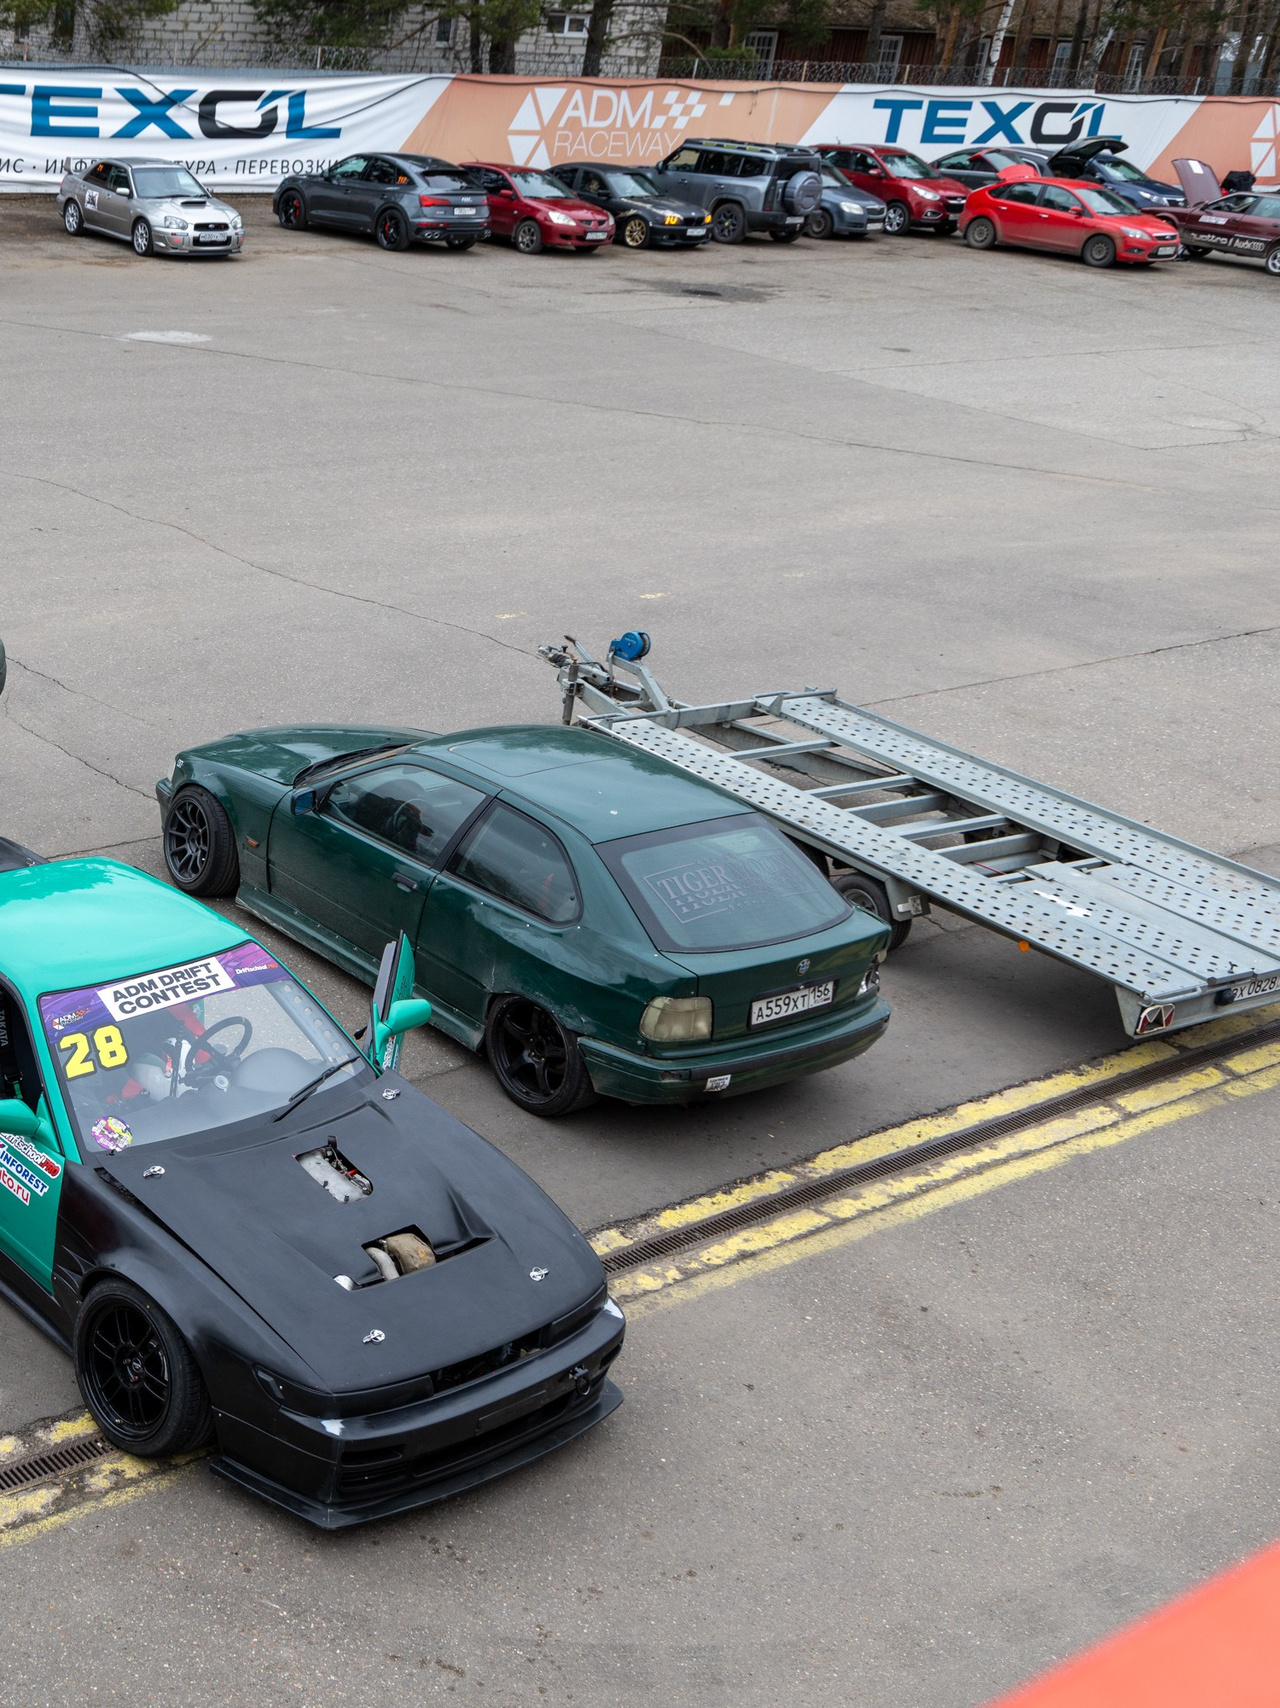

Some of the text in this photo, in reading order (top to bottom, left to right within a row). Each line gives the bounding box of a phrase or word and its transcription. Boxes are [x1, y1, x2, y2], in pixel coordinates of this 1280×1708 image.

[558, 89, 654, 128] ADM
[873, 99, 1123, 144] TEXOL
[553, 131, 681, 157] RACEWAY
[657, 864, 733, 900] TIGER
[112, 961, 213, 1003] ADM DRIFT
[118, 974, 222, 1015] CONTEST
[1247, 976, 1278, 996] 0828
[756, 983, 831, 1022] А559ХТ 156
[58, 1024, 129, 1080] 28
